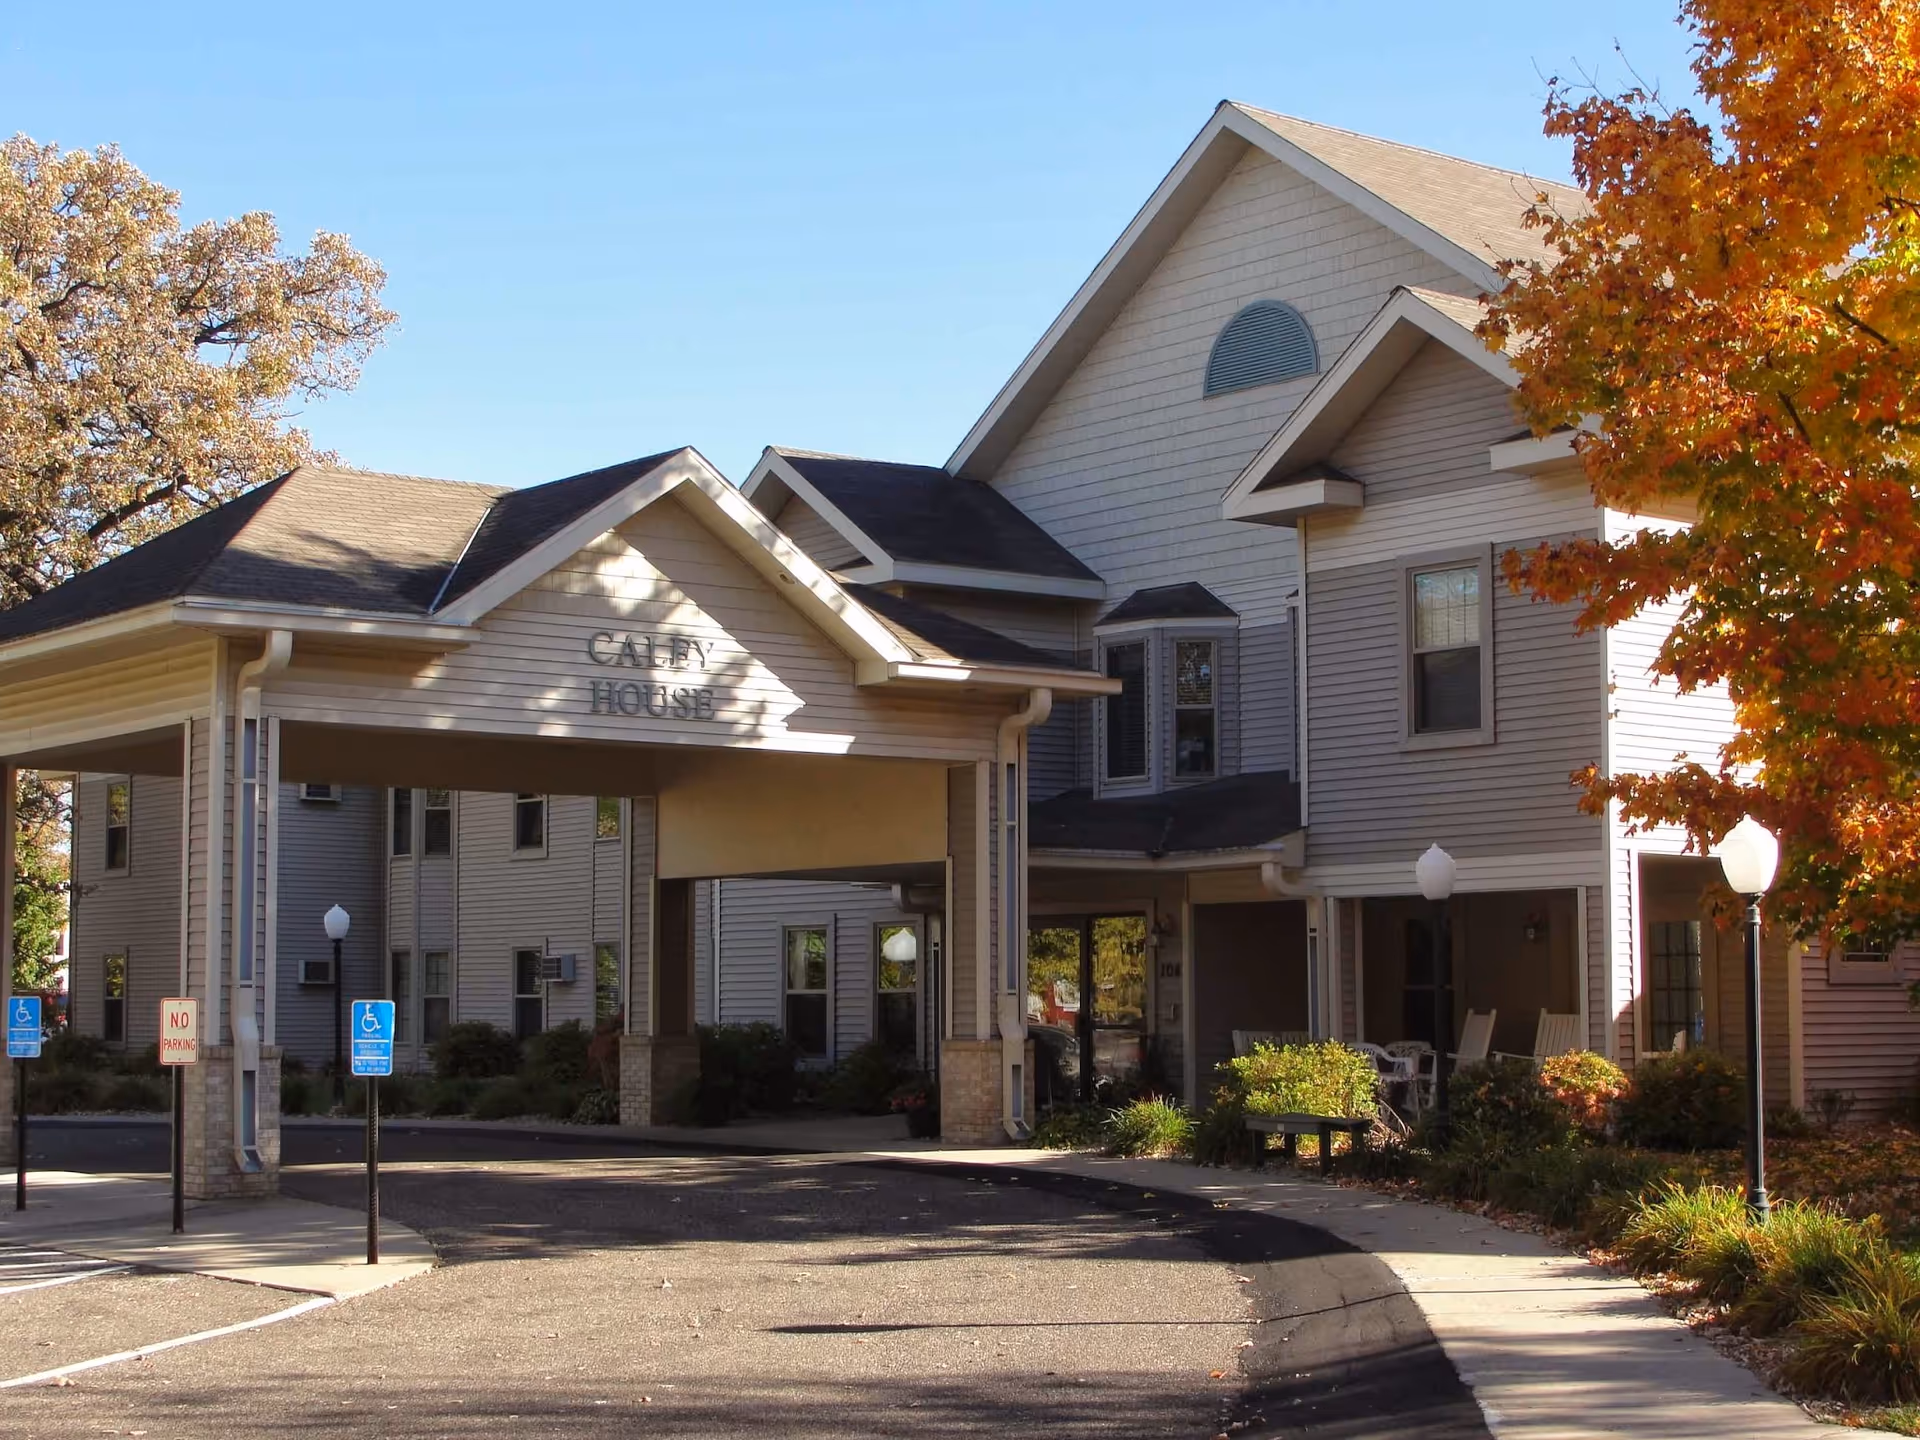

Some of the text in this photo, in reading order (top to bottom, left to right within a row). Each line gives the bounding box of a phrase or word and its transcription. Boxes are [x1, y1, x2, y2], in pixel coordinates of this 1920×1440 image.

[589, 681, 715, 720] HOUSE
[170, 1012, 189, 1028] NO
[163, 1038, 196, 1050] PARKING
